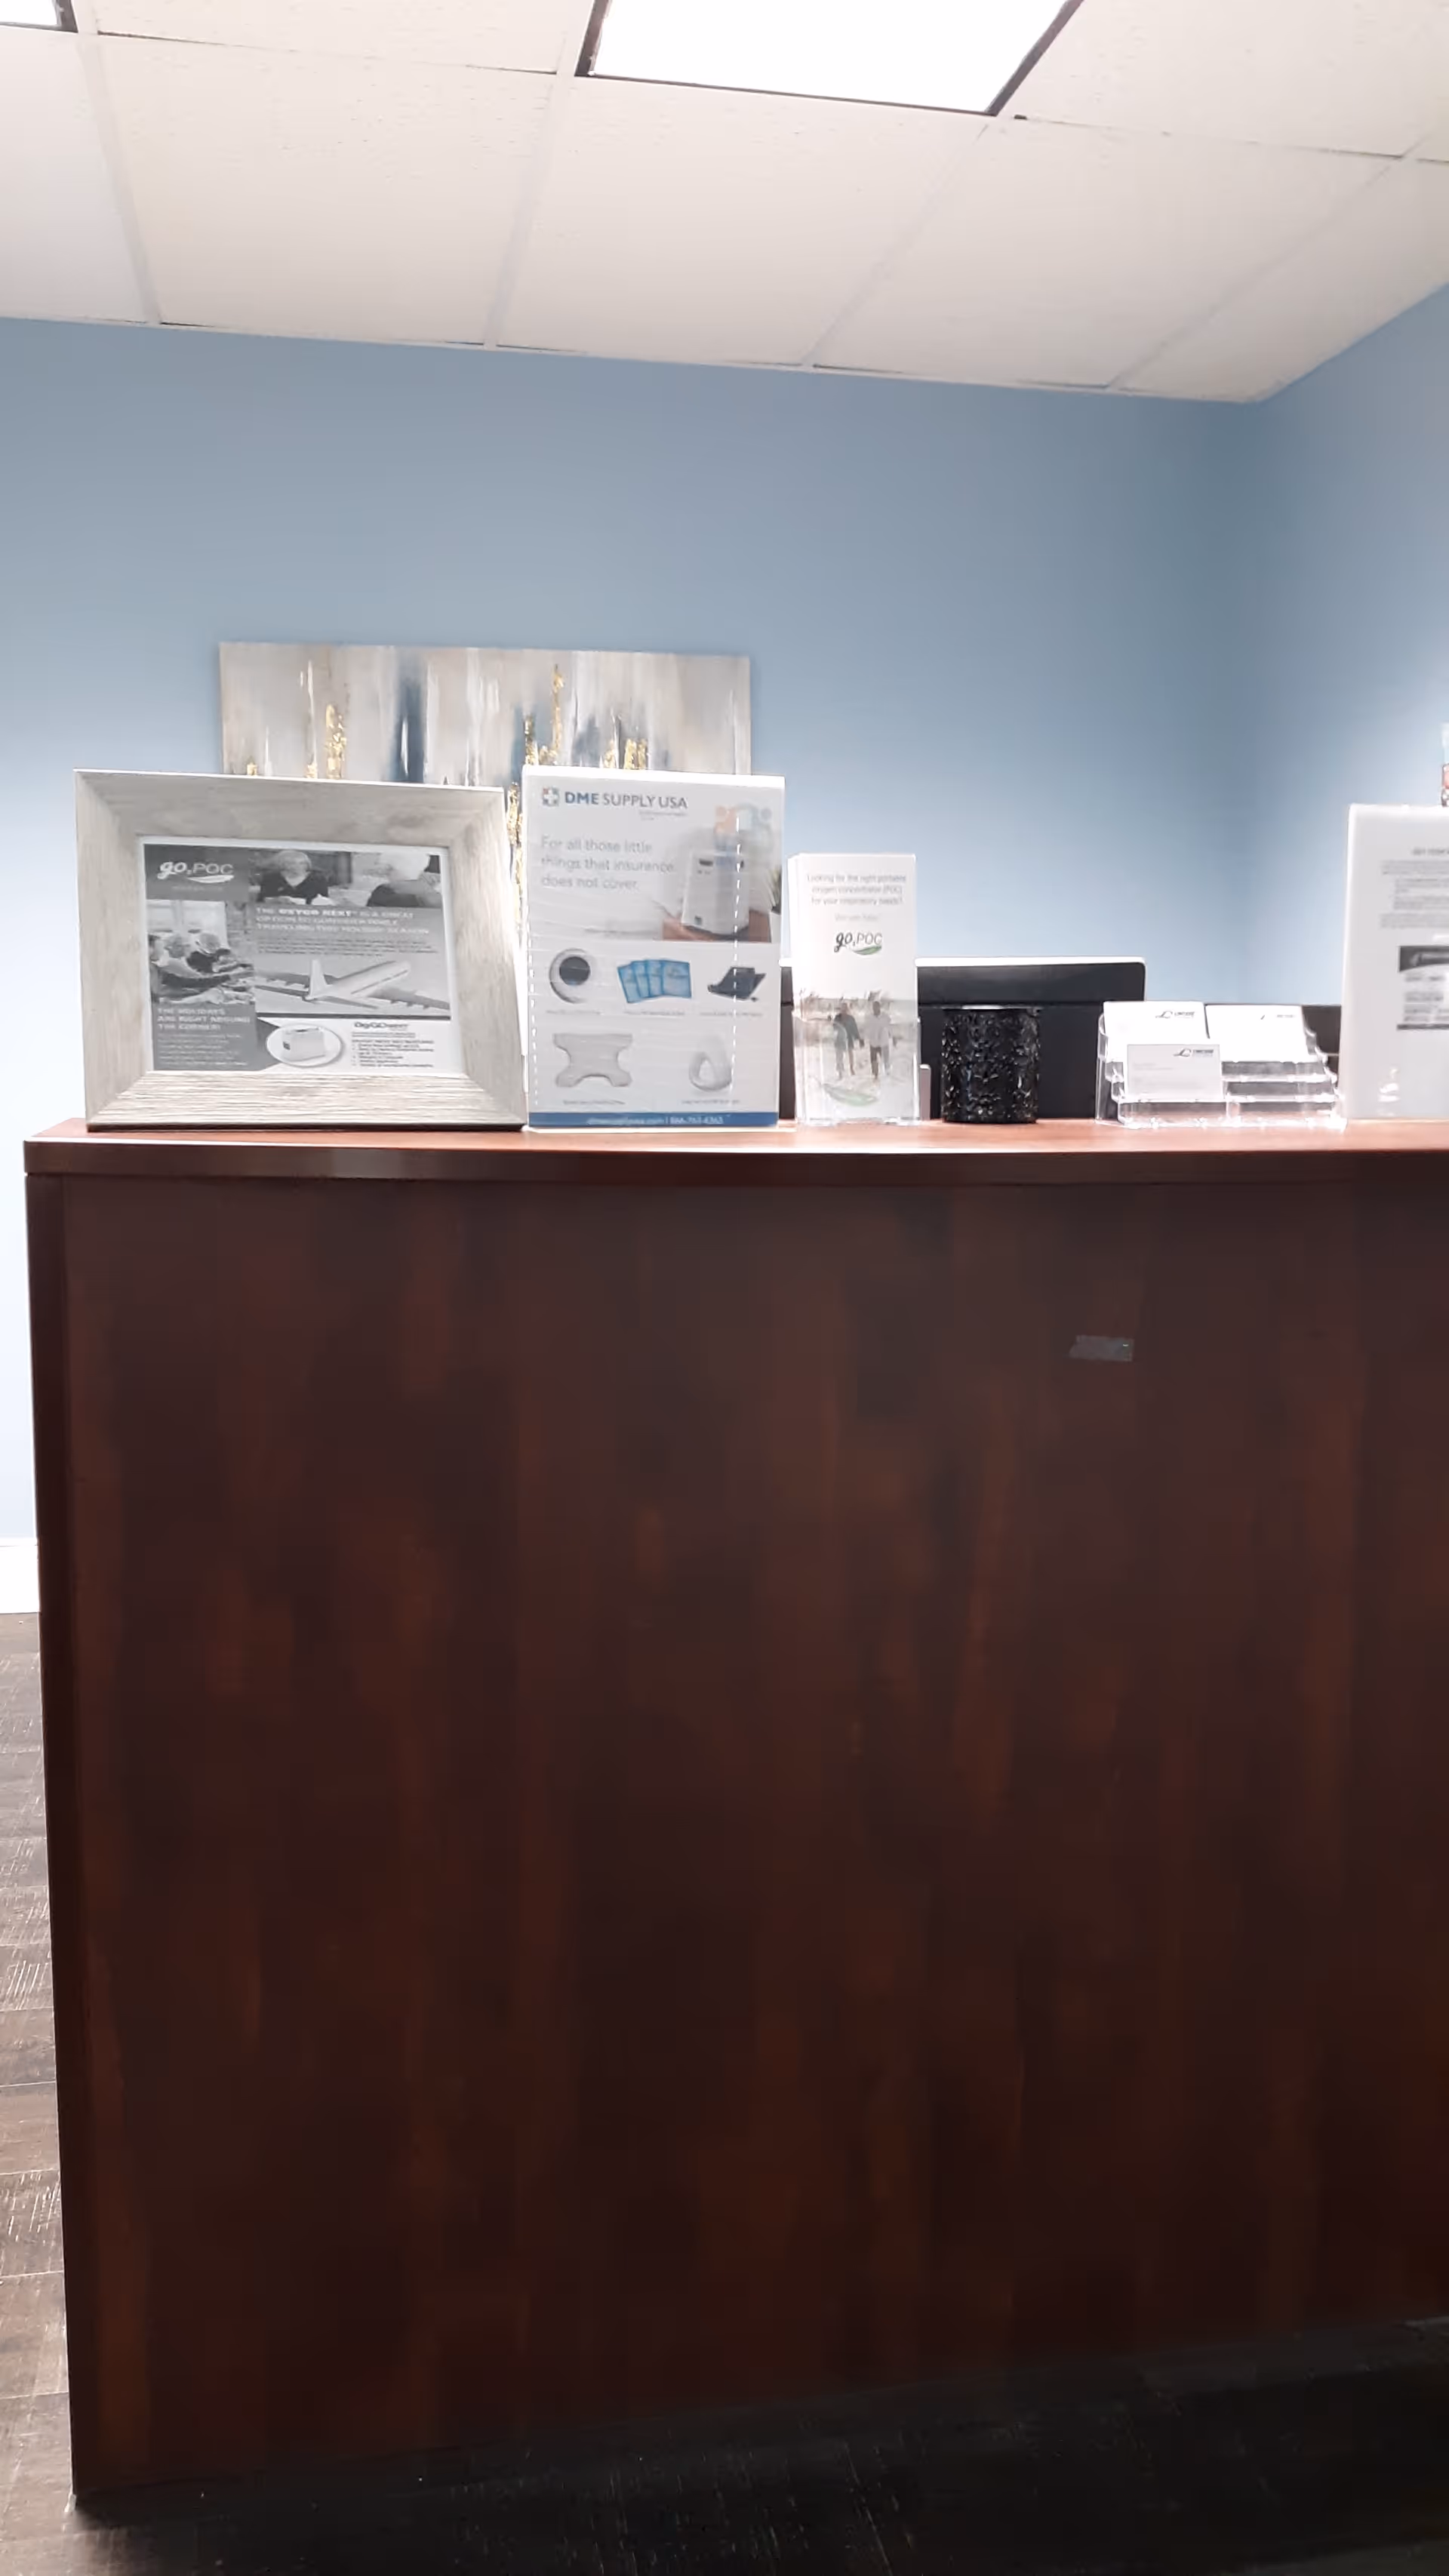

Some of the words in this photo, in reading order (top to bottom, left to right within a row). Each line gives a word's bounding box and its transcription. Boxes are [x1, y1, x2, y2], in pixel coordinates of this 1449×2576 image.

[565, 792, 599, 805] DME
[603, 793, 656, 808] SUPPLY
[658, 796, 688, 809] USA
[542, 835, 562, 848] For
[568, 839, 582, 851] all
[585, 839, 621, 852] those
[541, 855, 581, 872] things
[584, 858, 610, 870] that
[542, 873, 573, 888] does
[576, 876, 598, 888] not
